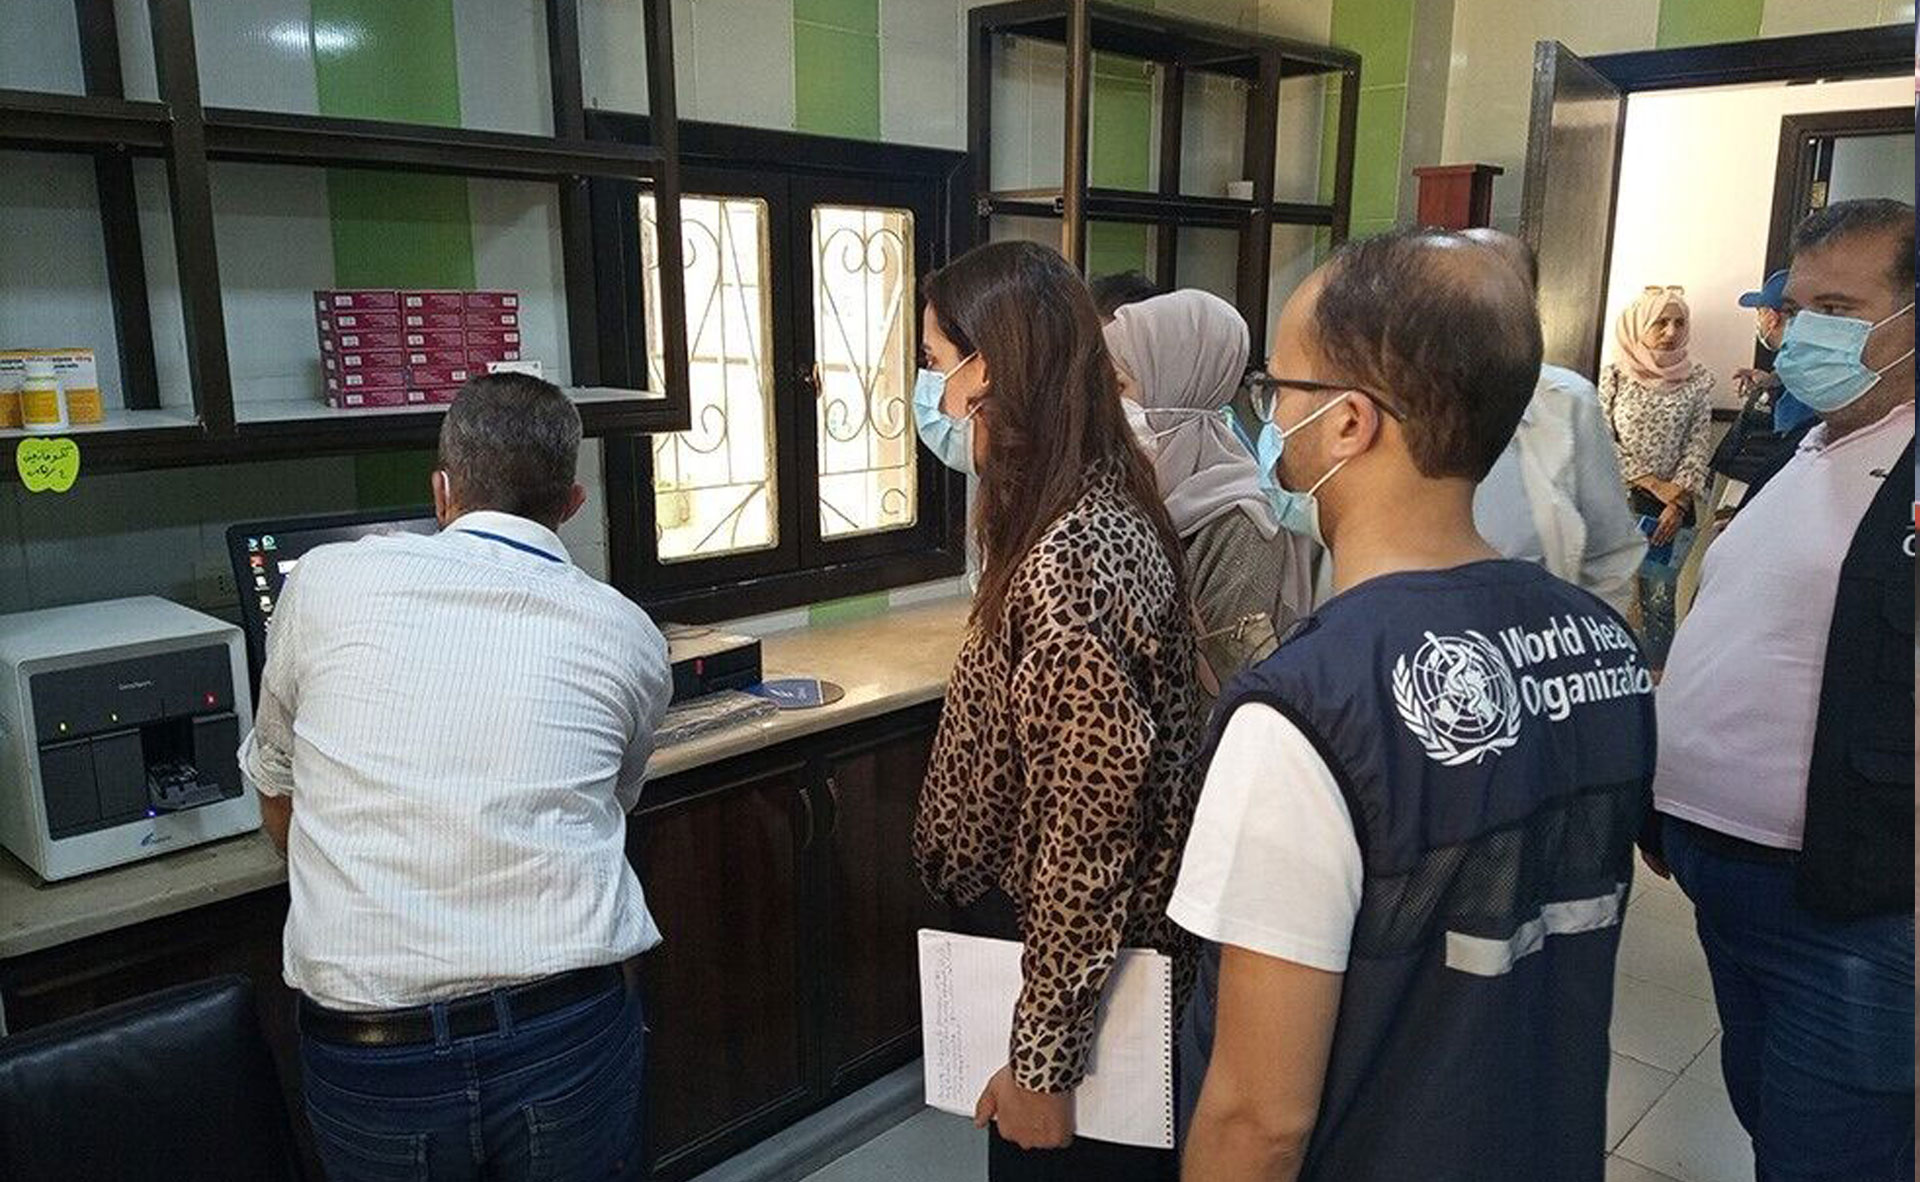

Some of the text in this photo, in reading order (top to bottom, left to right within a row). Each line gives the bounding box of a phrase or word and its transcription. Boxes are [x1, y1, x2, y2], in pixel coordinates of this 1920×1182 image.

[1498, 614, 1638, 669] World Hea
[1520, 654, 1653, 722] Oganizatio
